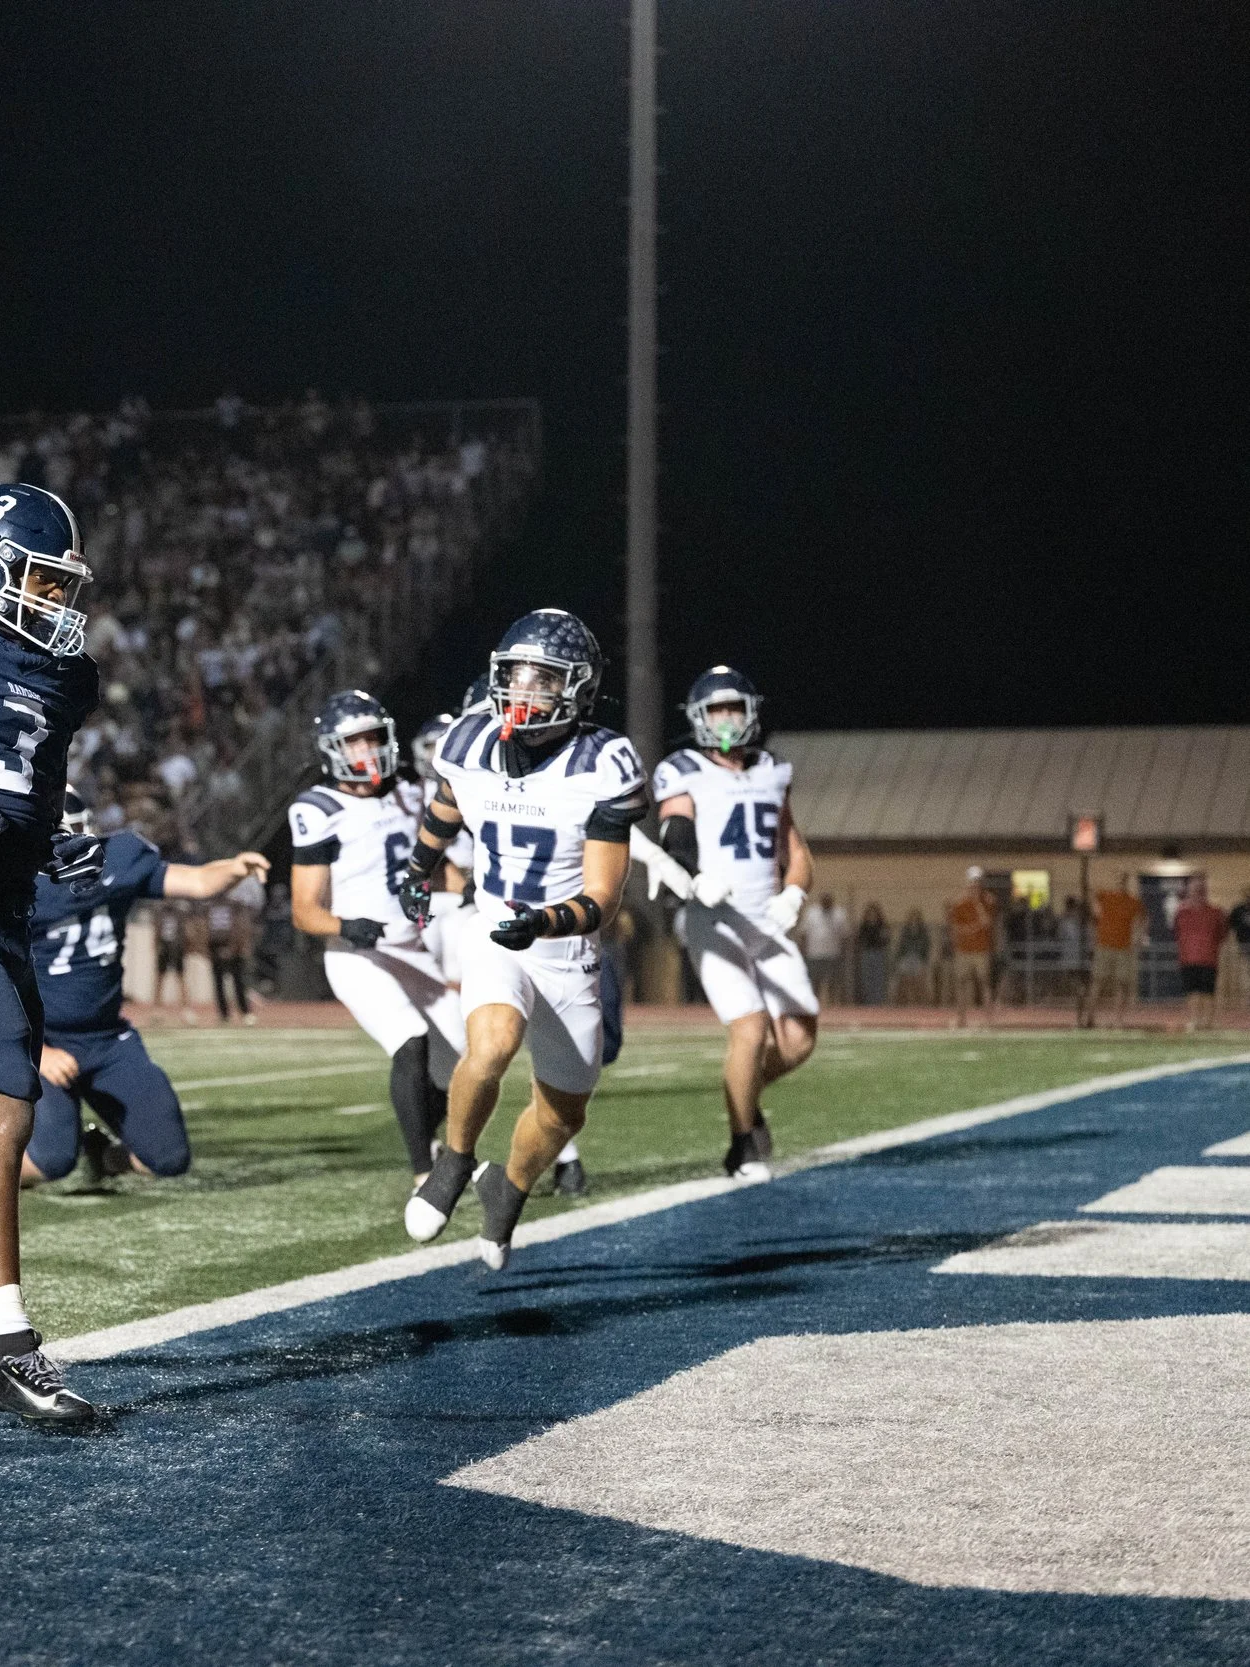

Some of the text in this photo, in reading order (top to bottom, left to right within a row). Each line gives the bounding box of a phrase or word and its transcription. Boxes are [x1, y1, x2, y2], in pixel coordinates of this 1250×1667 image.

[610, 746, 641, 785] 17
[484, 800, 546, 817] CHAMPION
[719, 801, 778, 859] 45
[480, 820, 557, 903] 17
[46, 904, 118, 975] 74
